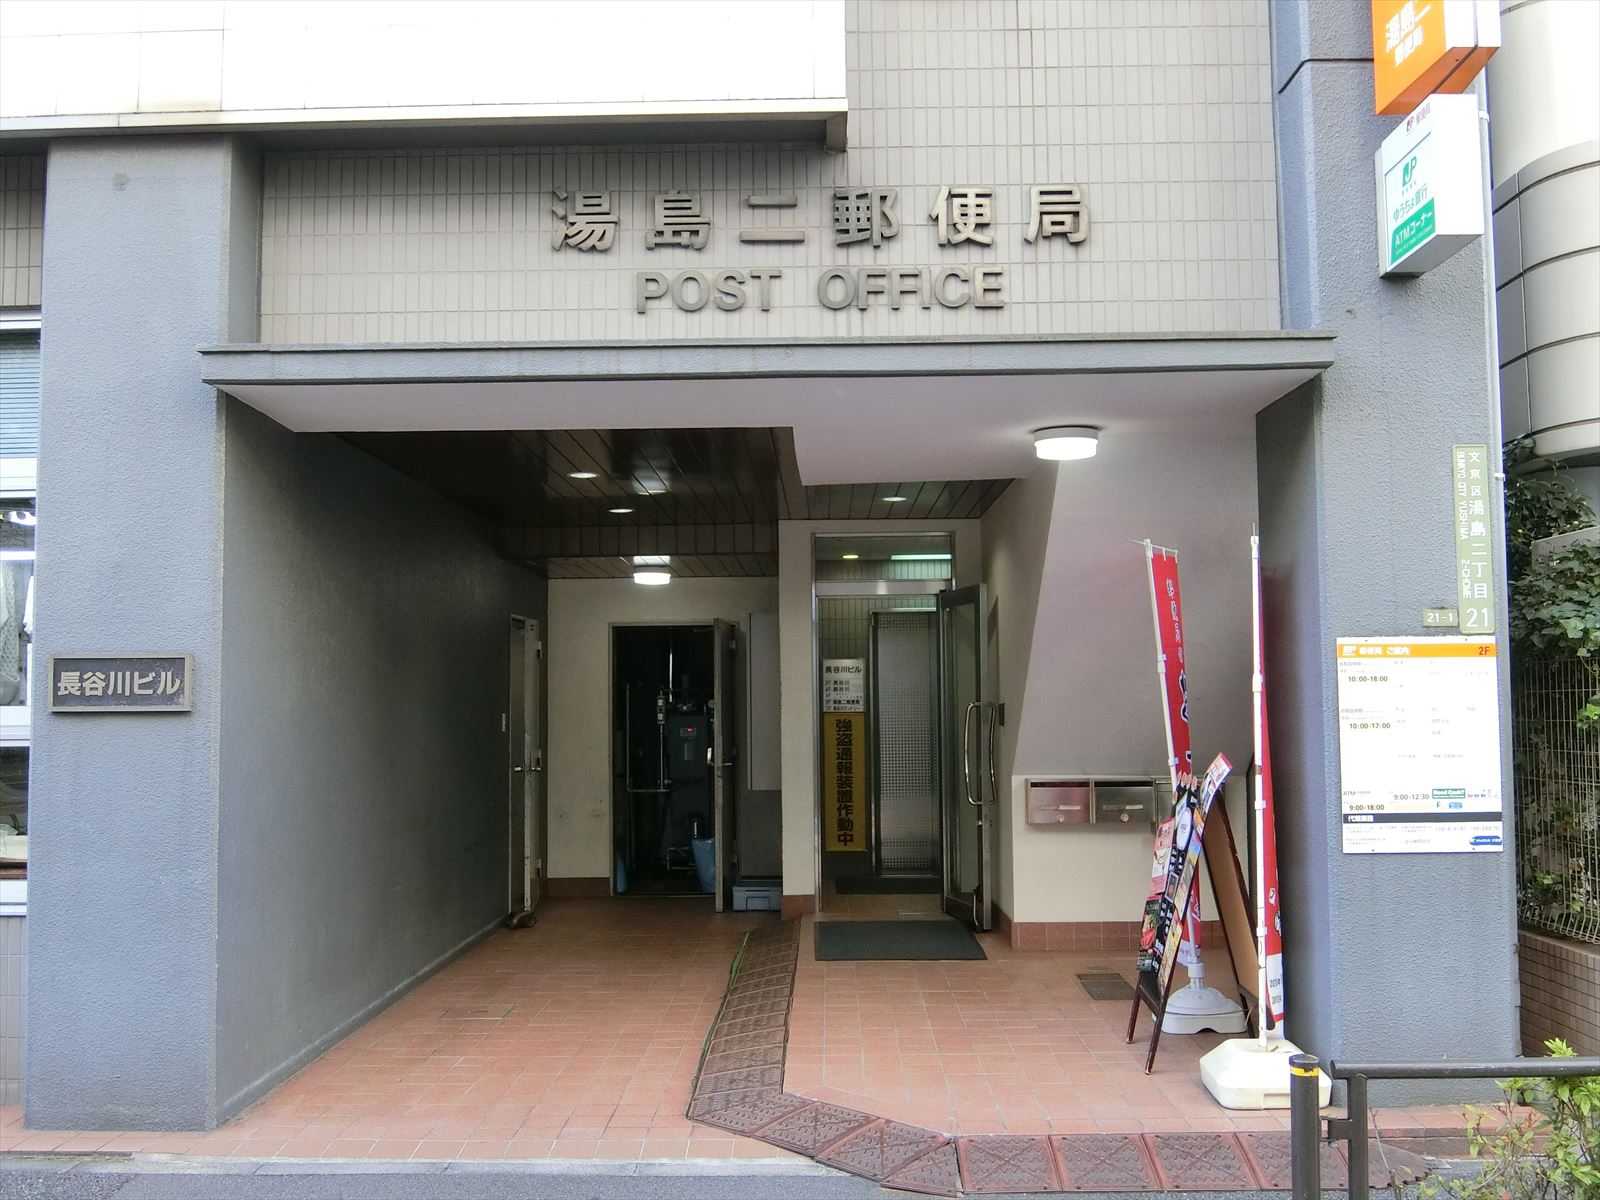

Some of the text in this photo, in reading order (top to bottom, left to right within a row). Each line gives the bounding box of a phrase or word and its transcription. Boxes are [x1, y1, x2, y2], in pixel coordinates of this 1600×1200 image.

[551, 185, 1091, 252] 湯島二郵便局
[1393, 183, 1428, 223] ゆうちょ銀行
[1395, 211, 1433, 247] ATMコーナー
[635, 264, 1006, 314] POST OFFICE
[1456, 451, 1466, 479] BUNKYO
[1458, 500, 1470, 540] YUSHIMA
[1468, 451, 1489, 599] 文京区湯島二丁目
[1461, 559, 1472, 599] 2-CHOME
[1427, 612, 1453, 623] 21-1
[1466, 608, 1489, 628] 21
[1478, 646, 1490, 656] 2F
[57, 671, 181, 697] 長谷川ビル
[825, 665, 862, 674] 長谷川ビル
[835, 718, 854, 848] 強盗通報装置作動中
[1393, 793, 1430, 801] 9:00-12:30
